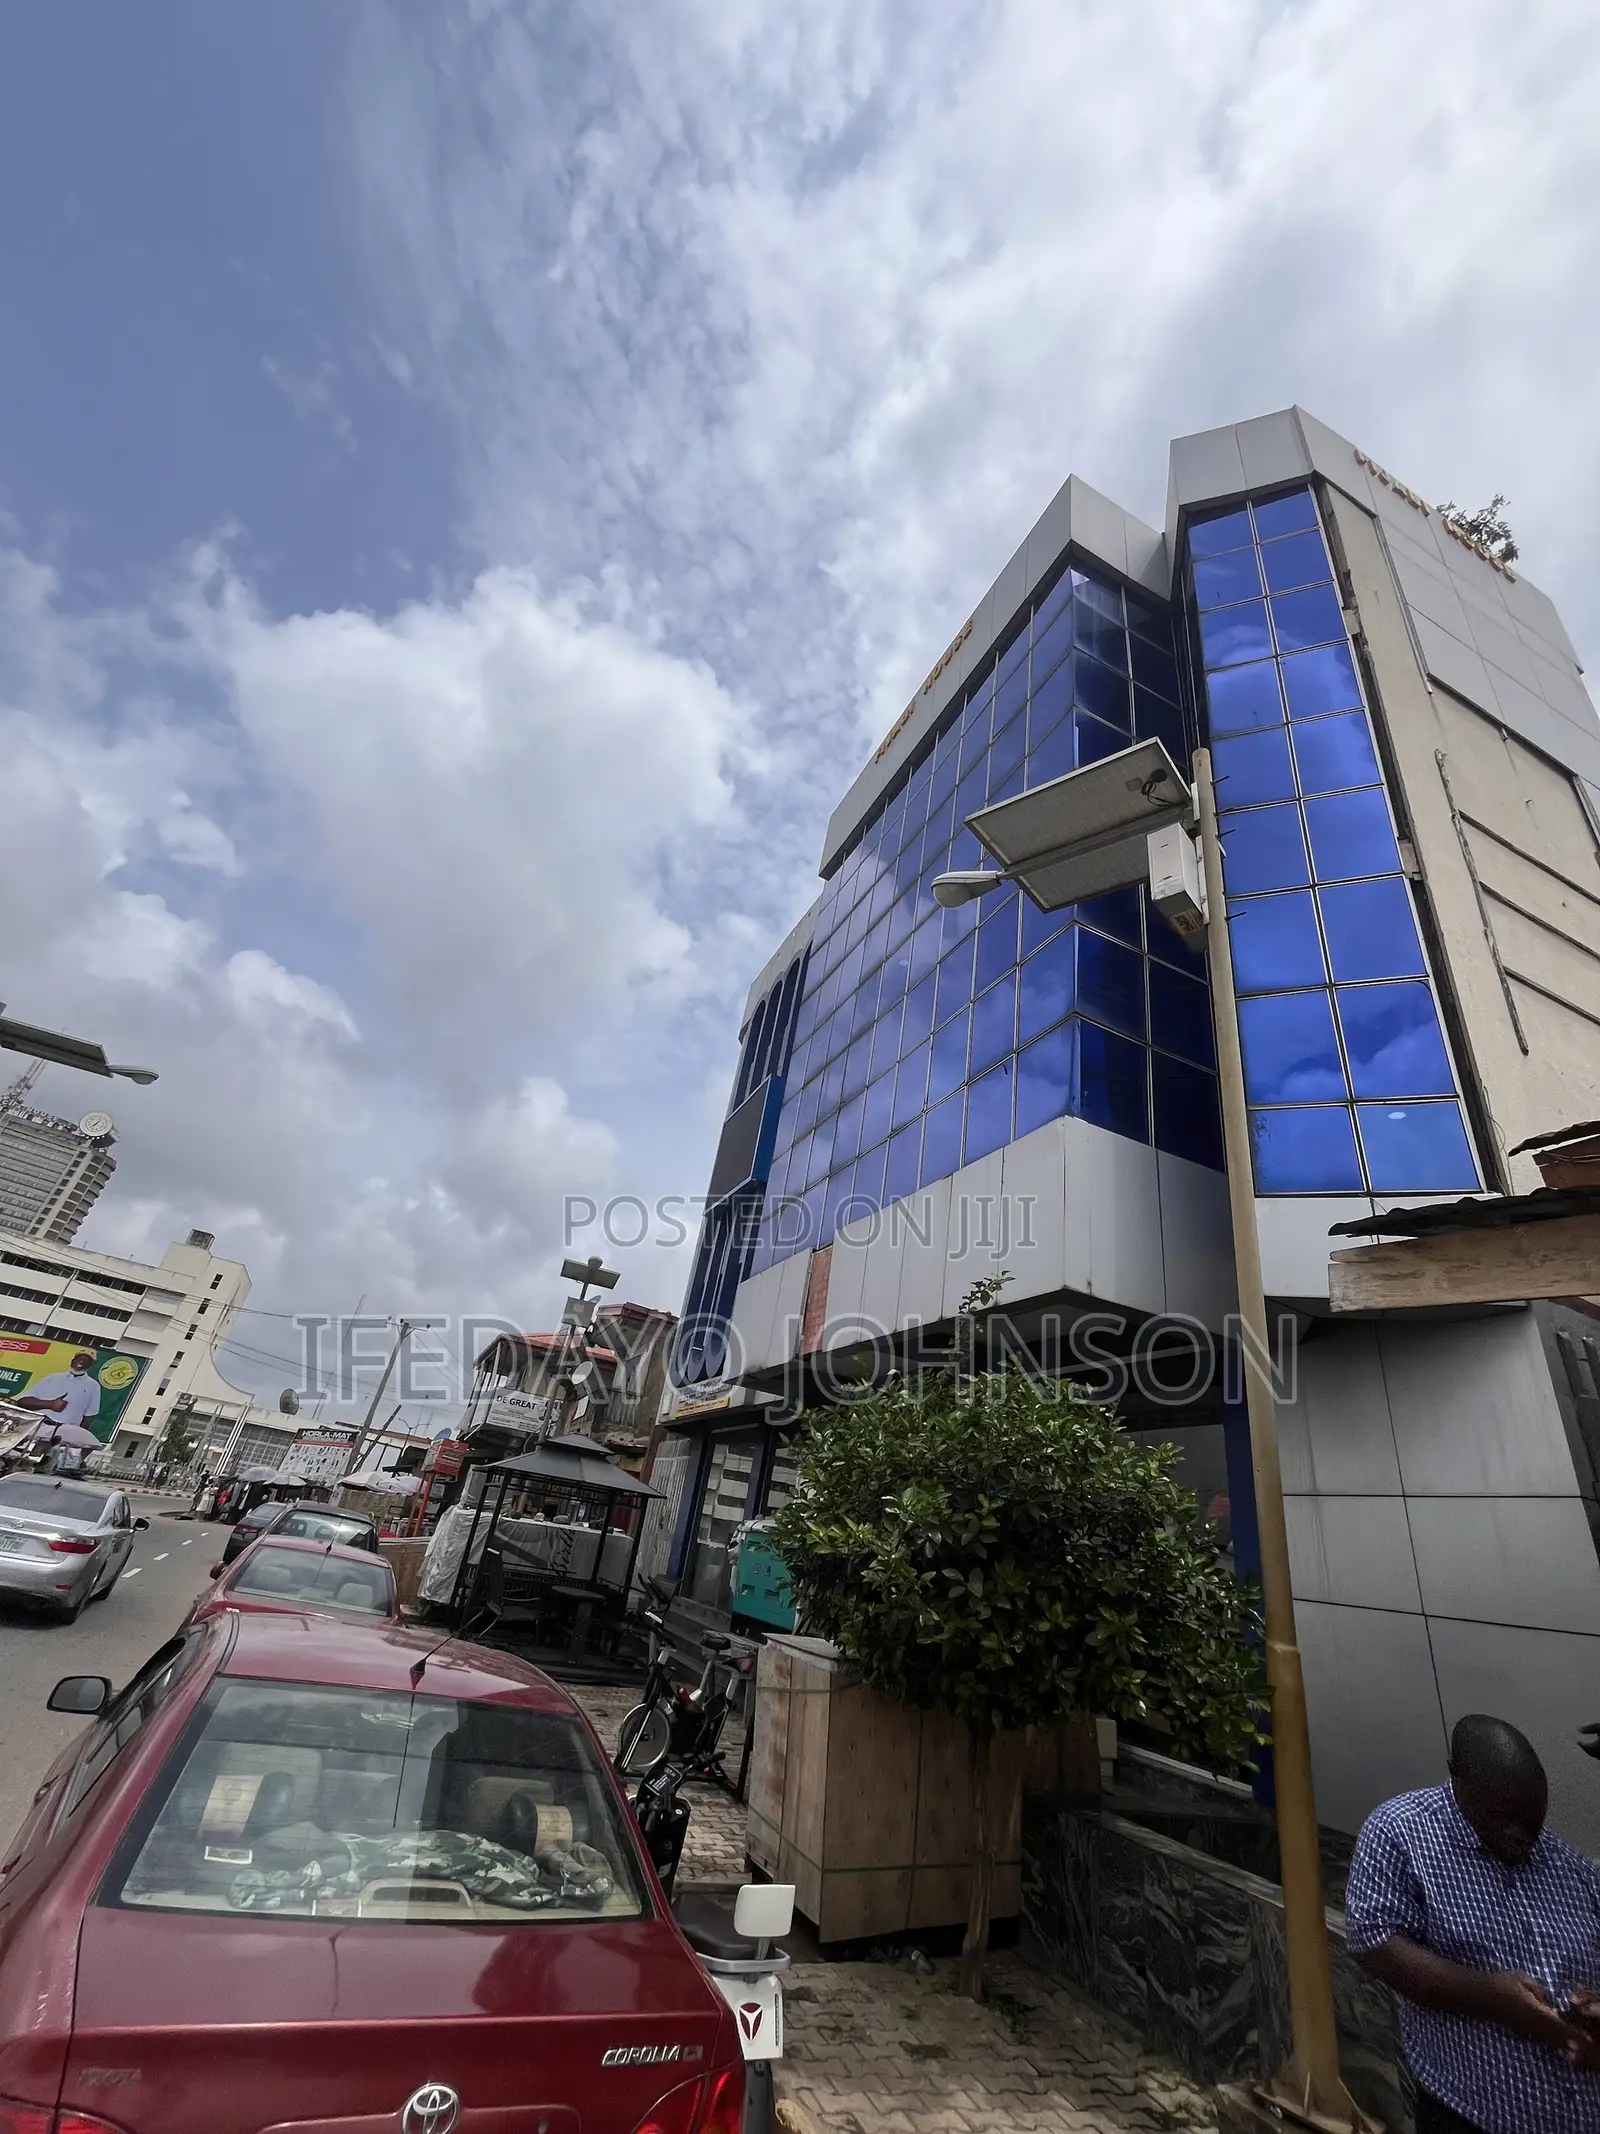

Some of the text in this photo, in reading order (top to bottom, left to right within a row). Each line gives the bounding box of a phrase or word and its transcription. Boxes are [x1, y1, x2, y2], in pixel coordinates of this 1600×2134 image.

[0, 1339, 30, 1351] ESS
[496, 1395, 537, 1410] DE GREAT
